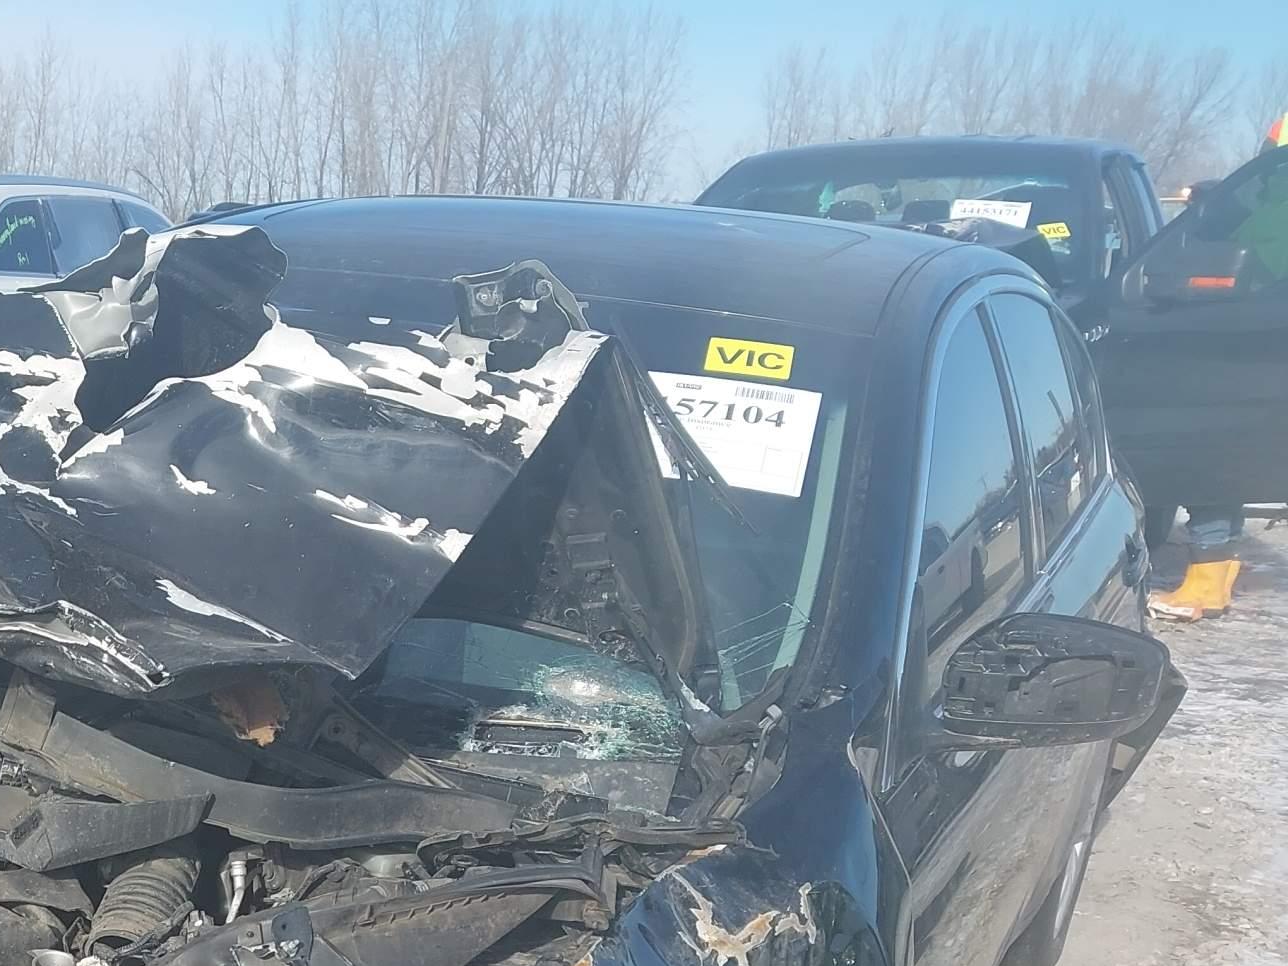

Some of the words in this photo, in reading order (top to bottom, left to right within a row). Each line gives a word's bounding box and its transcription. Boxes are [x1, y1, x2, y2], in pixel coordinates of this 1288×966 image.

[1042, 225, 1067, 235] VIC
[716, 346, 785, 370] VIC
[663, 396, 786, 429] 57104
